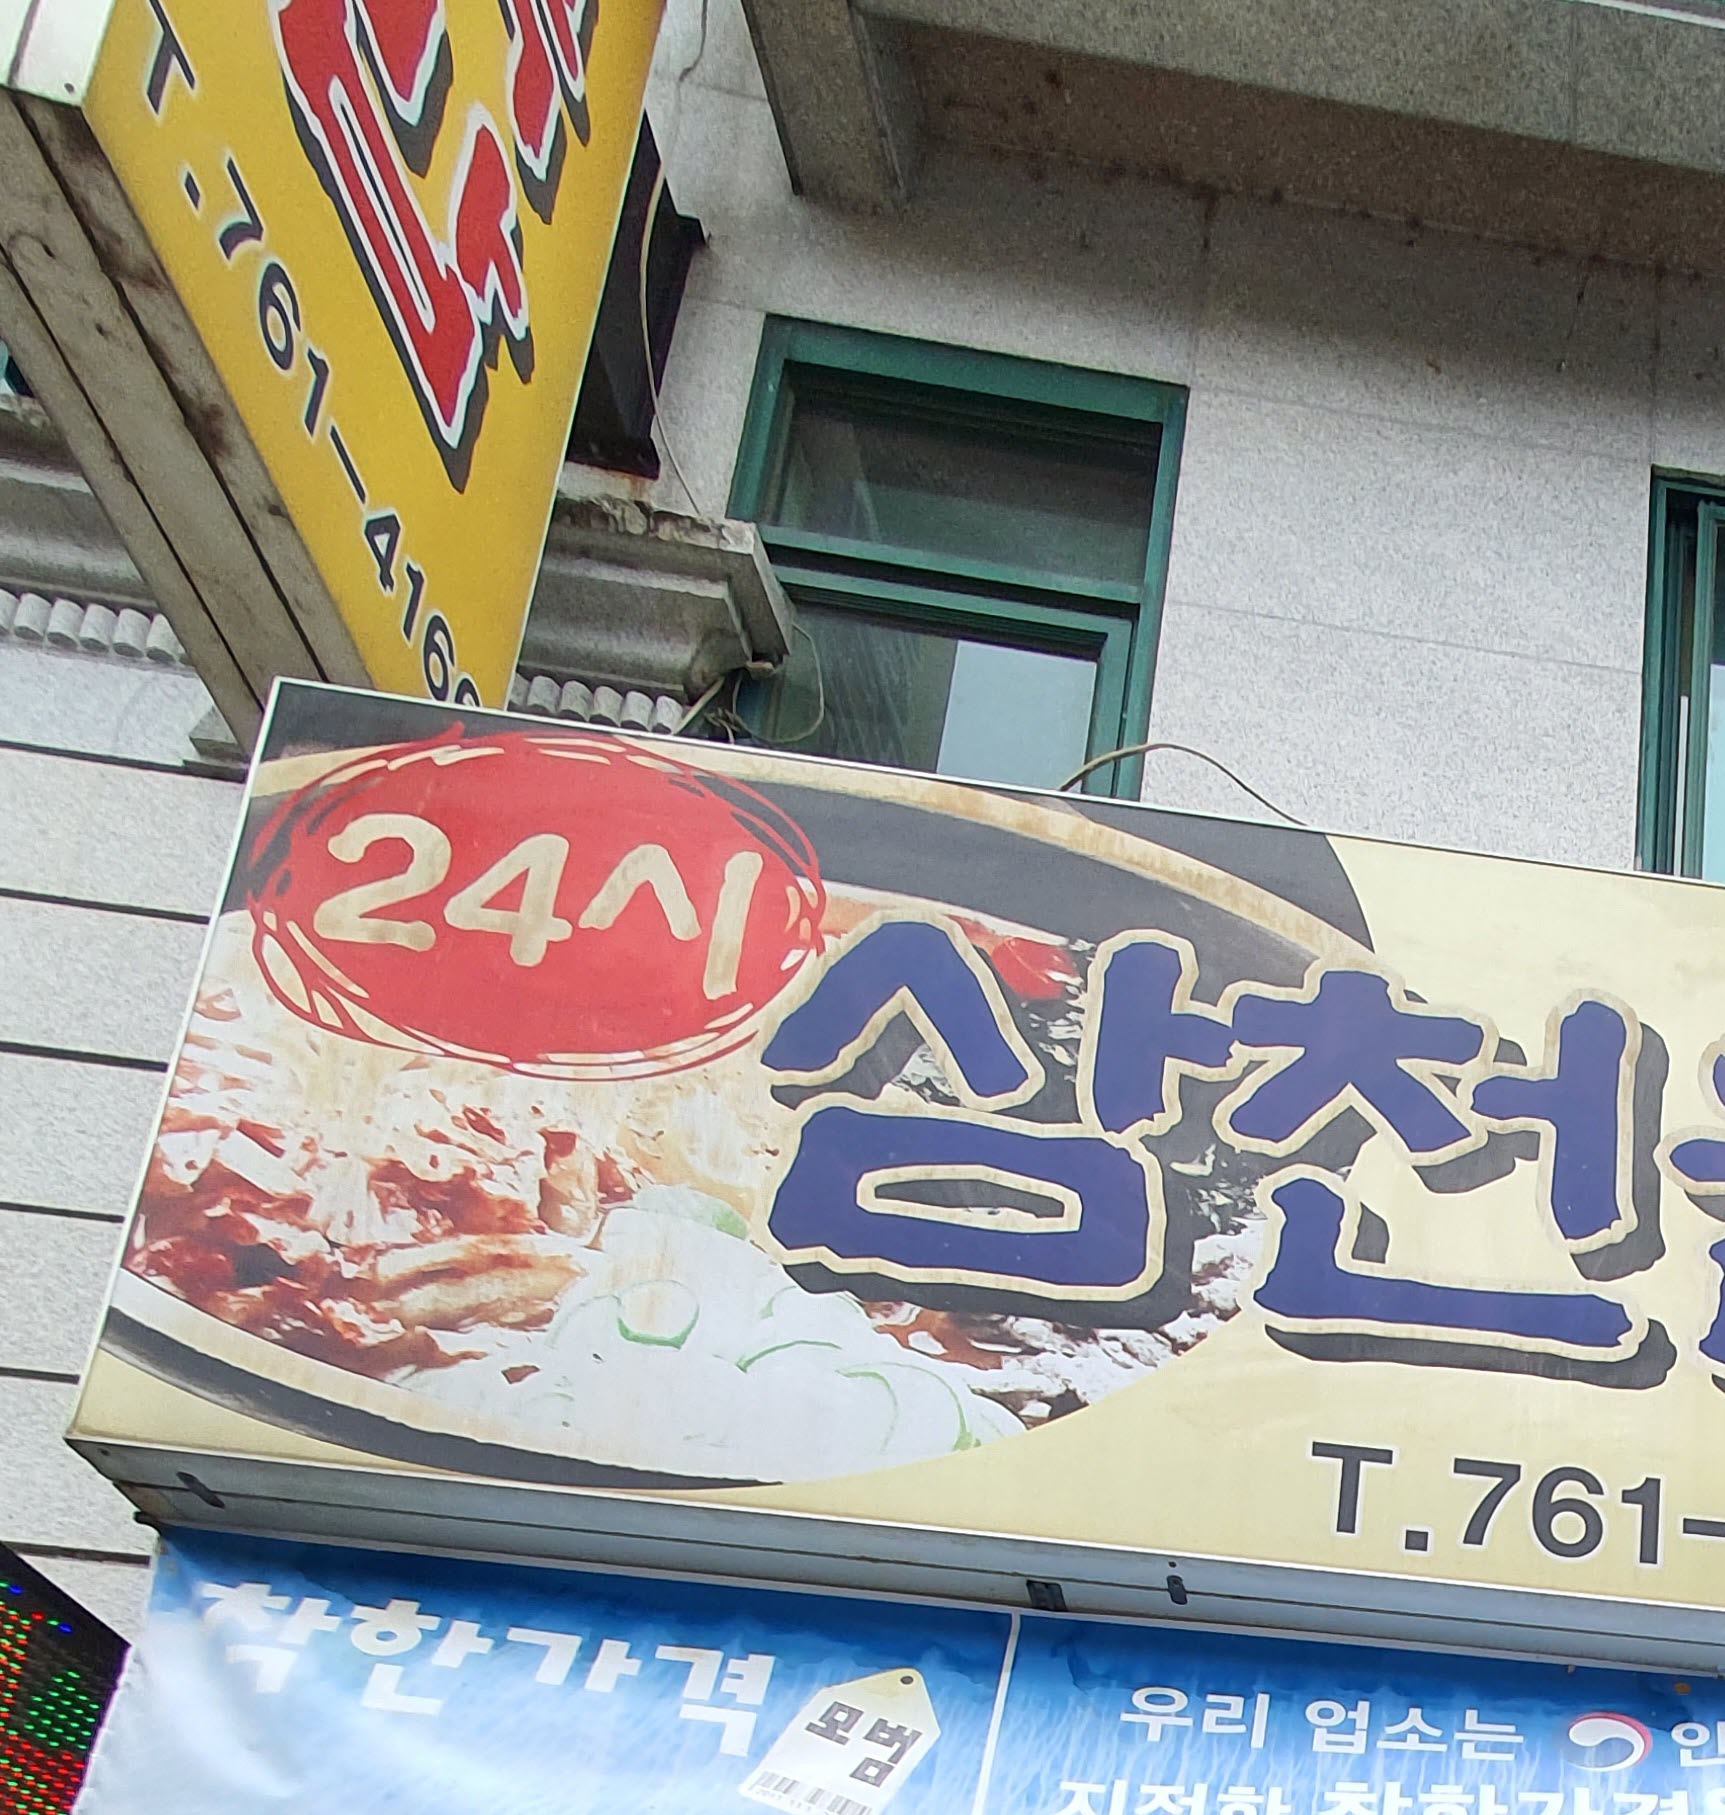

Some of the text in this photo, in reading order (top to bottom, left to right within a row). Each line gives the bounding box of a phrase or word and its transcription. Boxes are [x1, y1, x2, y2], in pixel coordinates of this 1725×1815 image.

[312, 811, 764, 1002] 24시
[202, 1580, 776, 1758] 착한가격
[1118, 1686, 1271, 1752] 우리
[1304, 1695, 1526, 1764] 업소는
[805, 1700, 924, 1789] 모범
